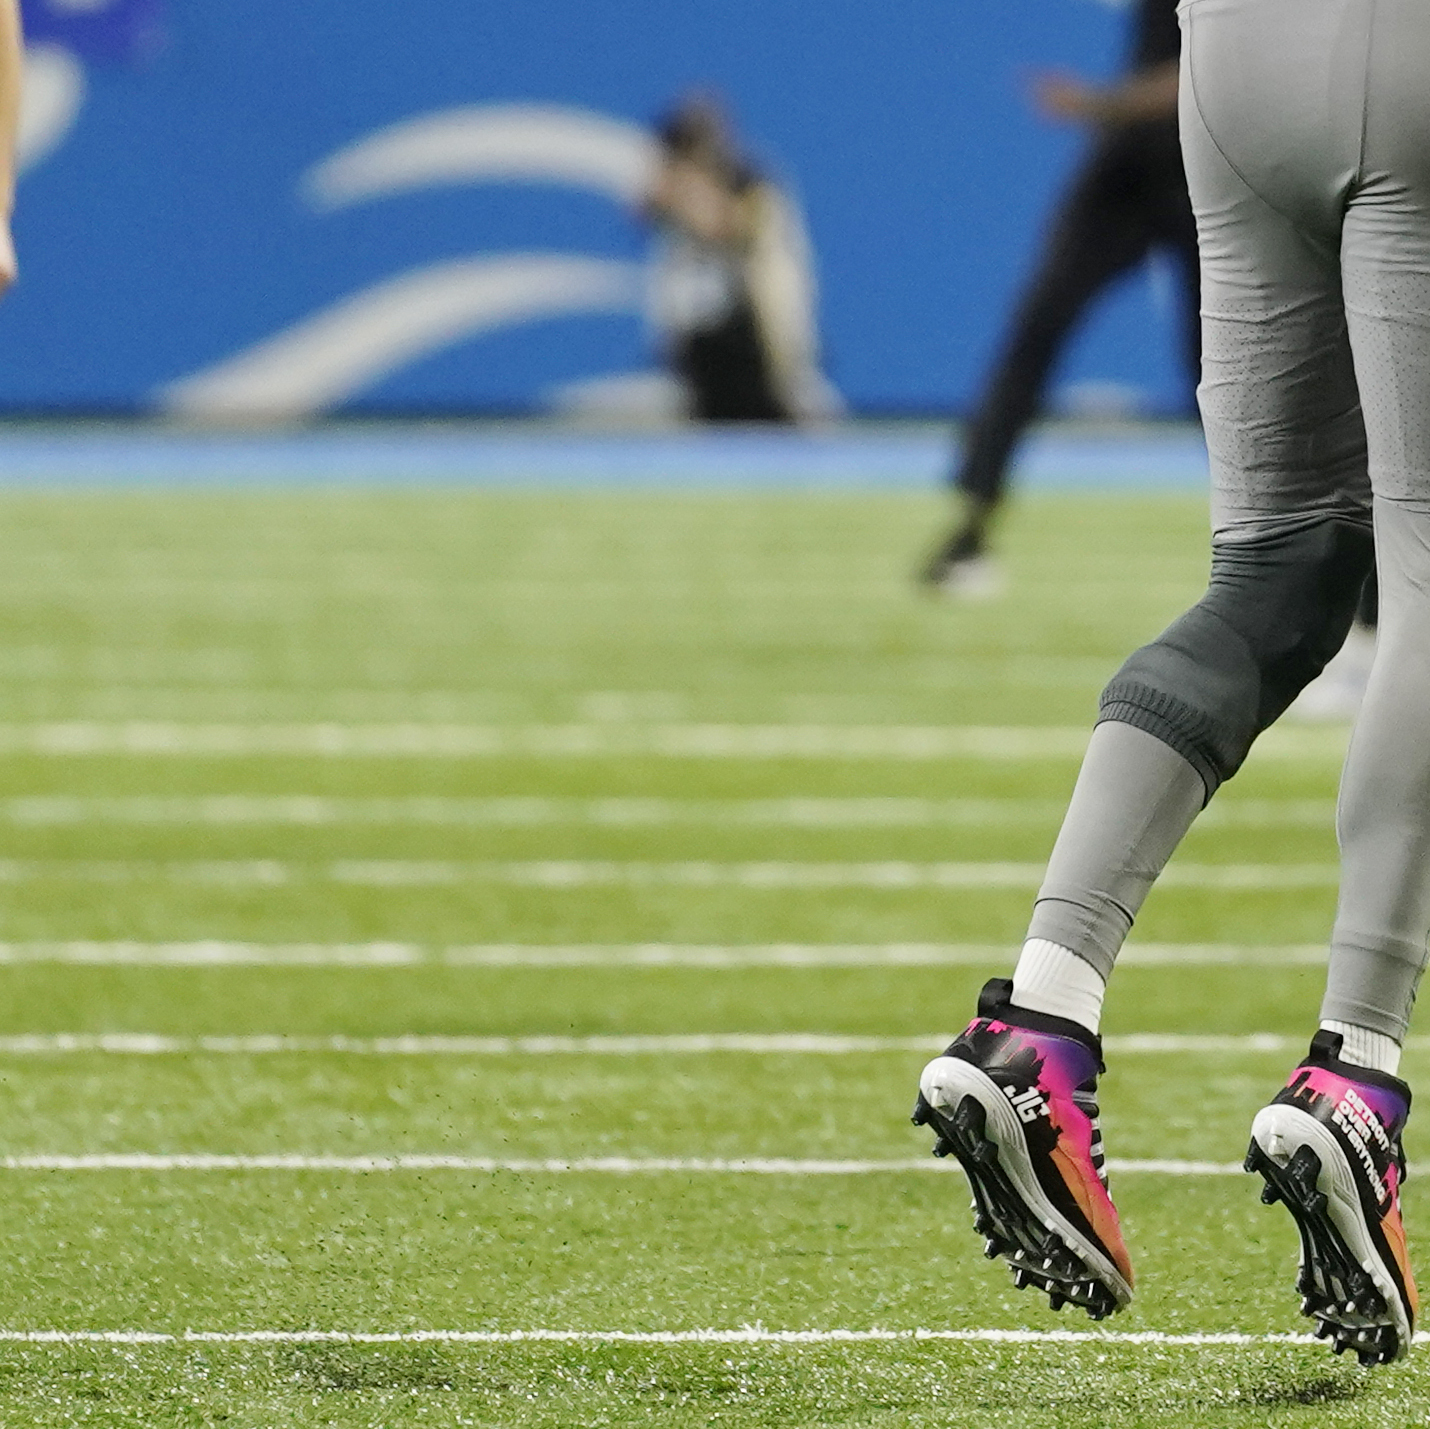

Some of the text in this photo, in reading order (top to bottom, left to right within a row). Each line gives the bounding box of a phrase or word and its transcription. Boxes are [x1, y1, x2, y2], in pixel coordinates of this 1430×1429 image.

[1338, 1100, 1372, 1144] OVER
[1344, 1088, 1391, 1152] DETROIT
[1331, 1108, 1387, 1205] EVERYTHING
